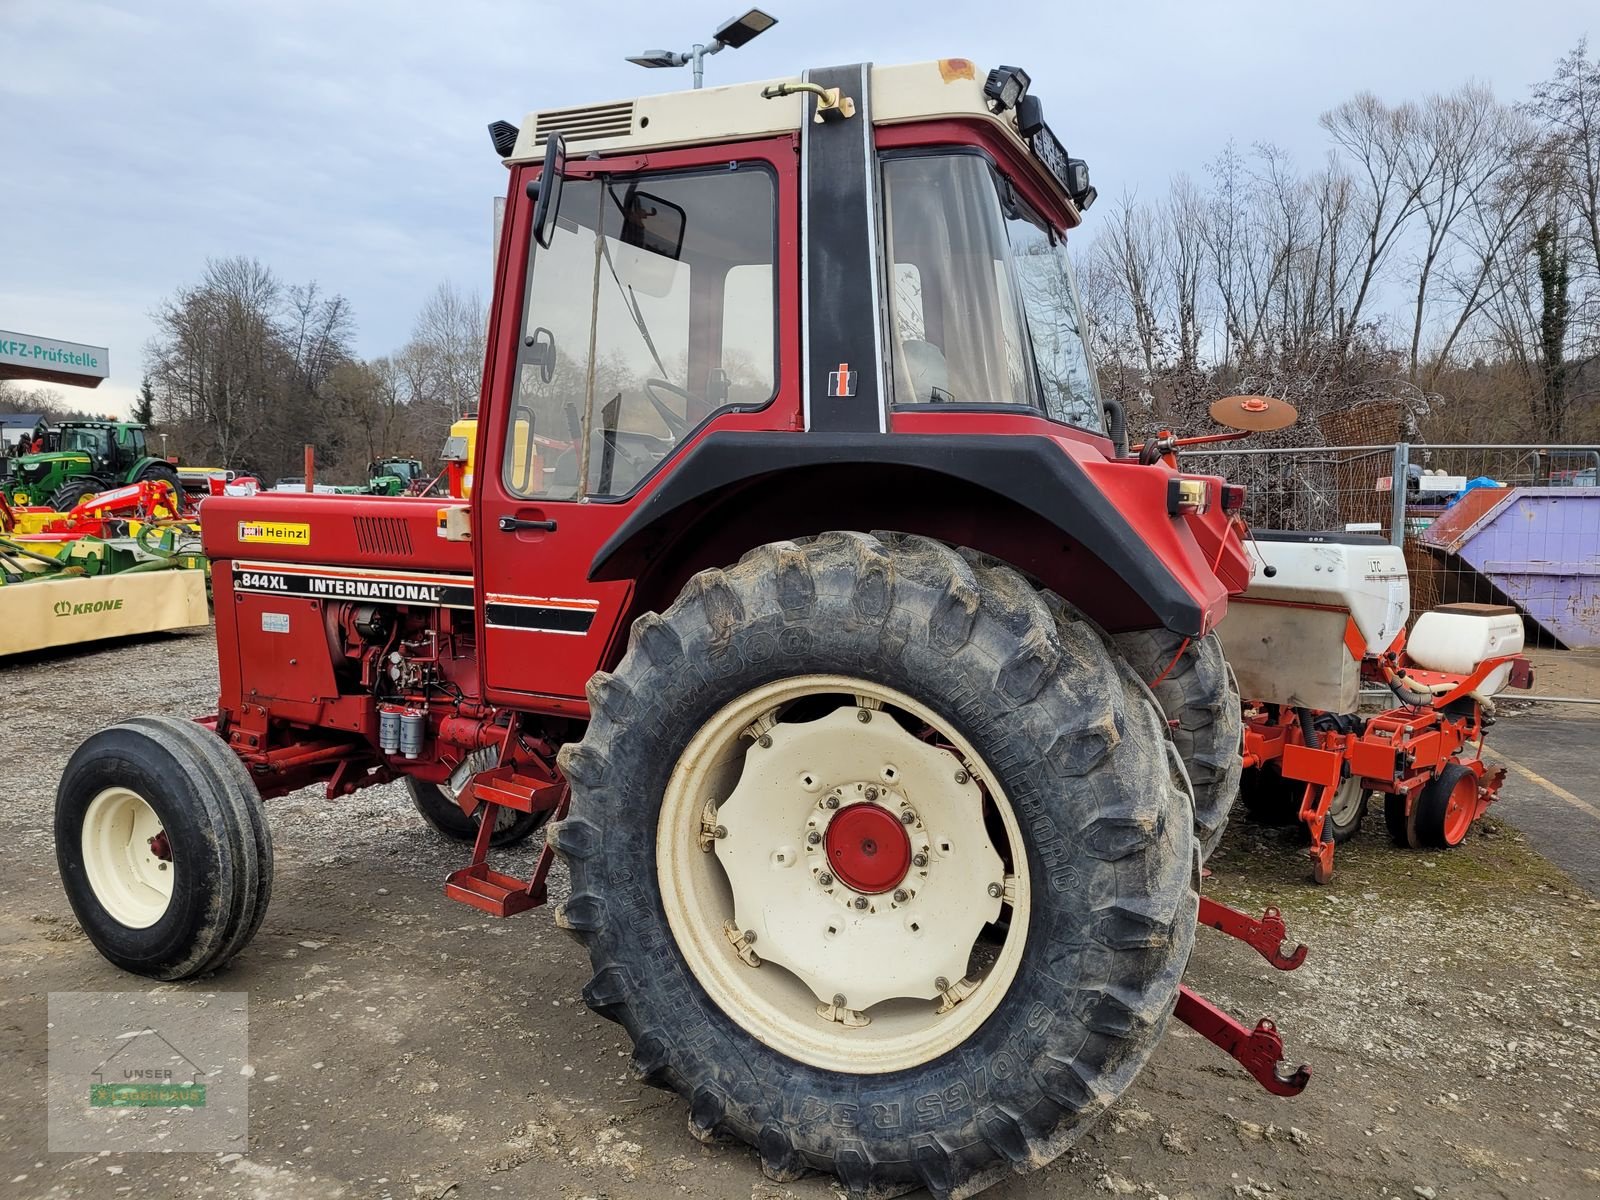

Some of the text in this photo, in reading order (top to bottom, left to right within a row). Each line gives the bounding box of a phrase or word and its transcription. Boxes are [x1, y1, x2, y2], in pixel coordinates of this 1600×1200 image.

[0, 340, 98, 368] KFZ-Prüfstelle
[266, 527, 306, 539] Heinzl
[242, 573, 439, 601] 844XL INTERNATIONAL
[73, 600, 123, 615] KRONE
[947, 672, 1082, 893] TRELLEBORG
